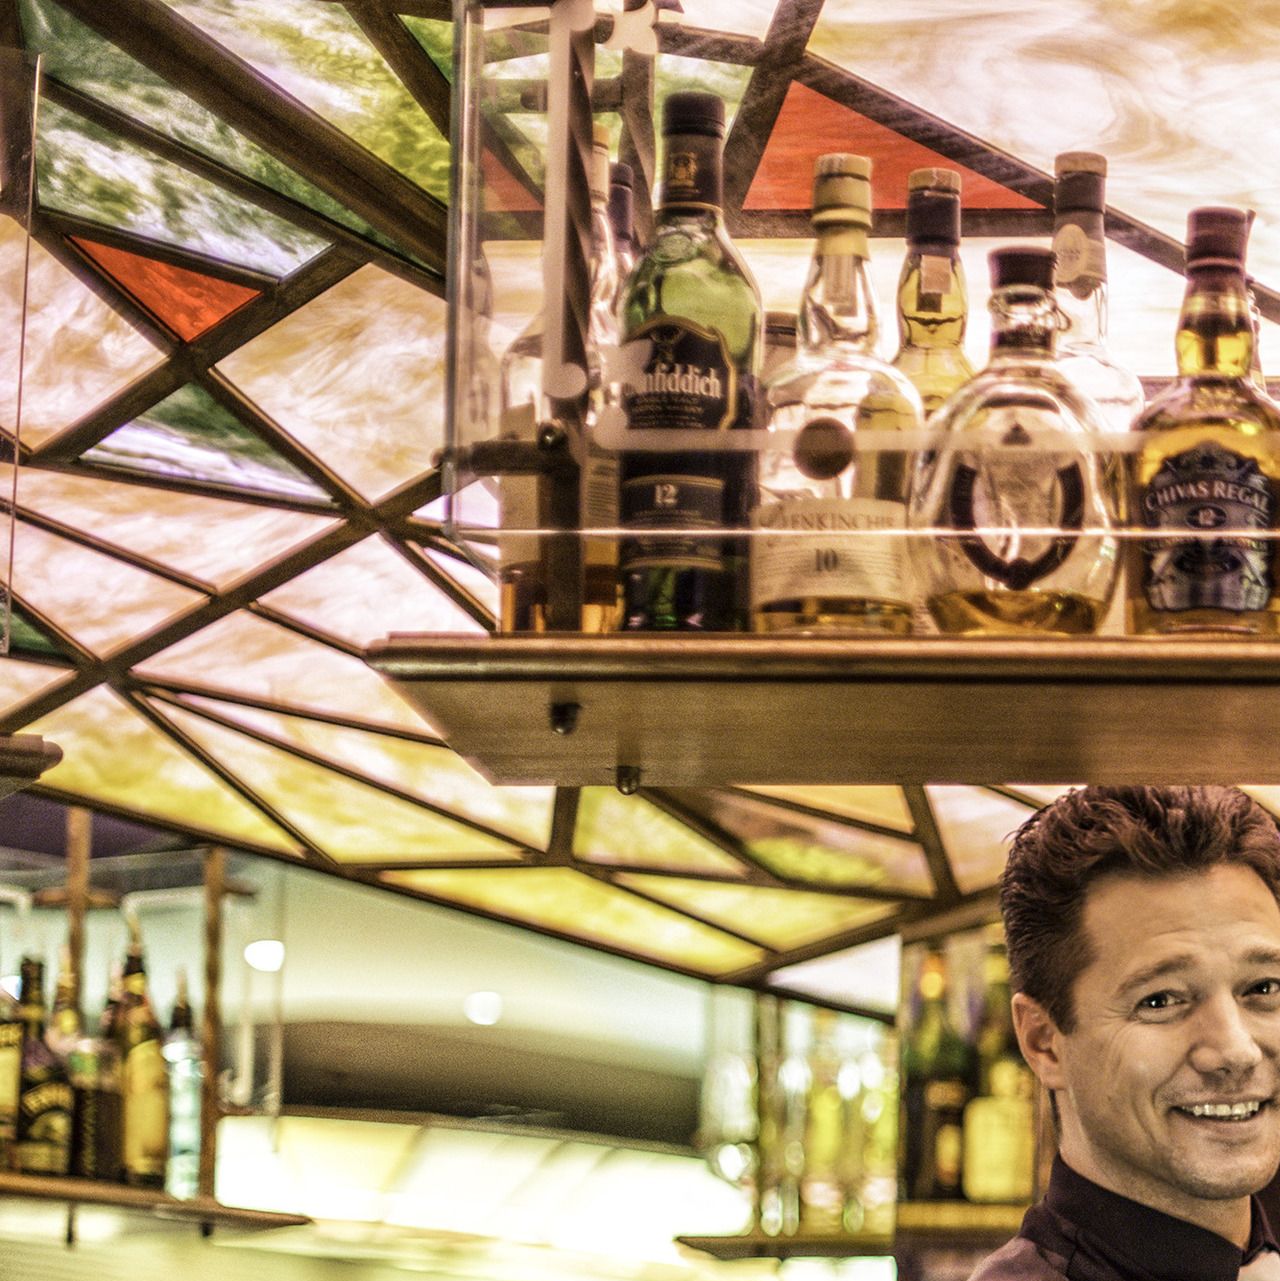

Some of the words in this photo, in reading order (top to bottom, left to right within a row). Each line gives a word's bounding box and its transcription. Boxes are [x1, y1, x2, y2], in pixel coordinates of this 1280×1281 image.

[654, 484, 679, 505] 12
[1145, 480, 1210, 512] CHIVAS
[1212, 480, 1269, 515] REGAL
[815, 547, 839, 572] 10
